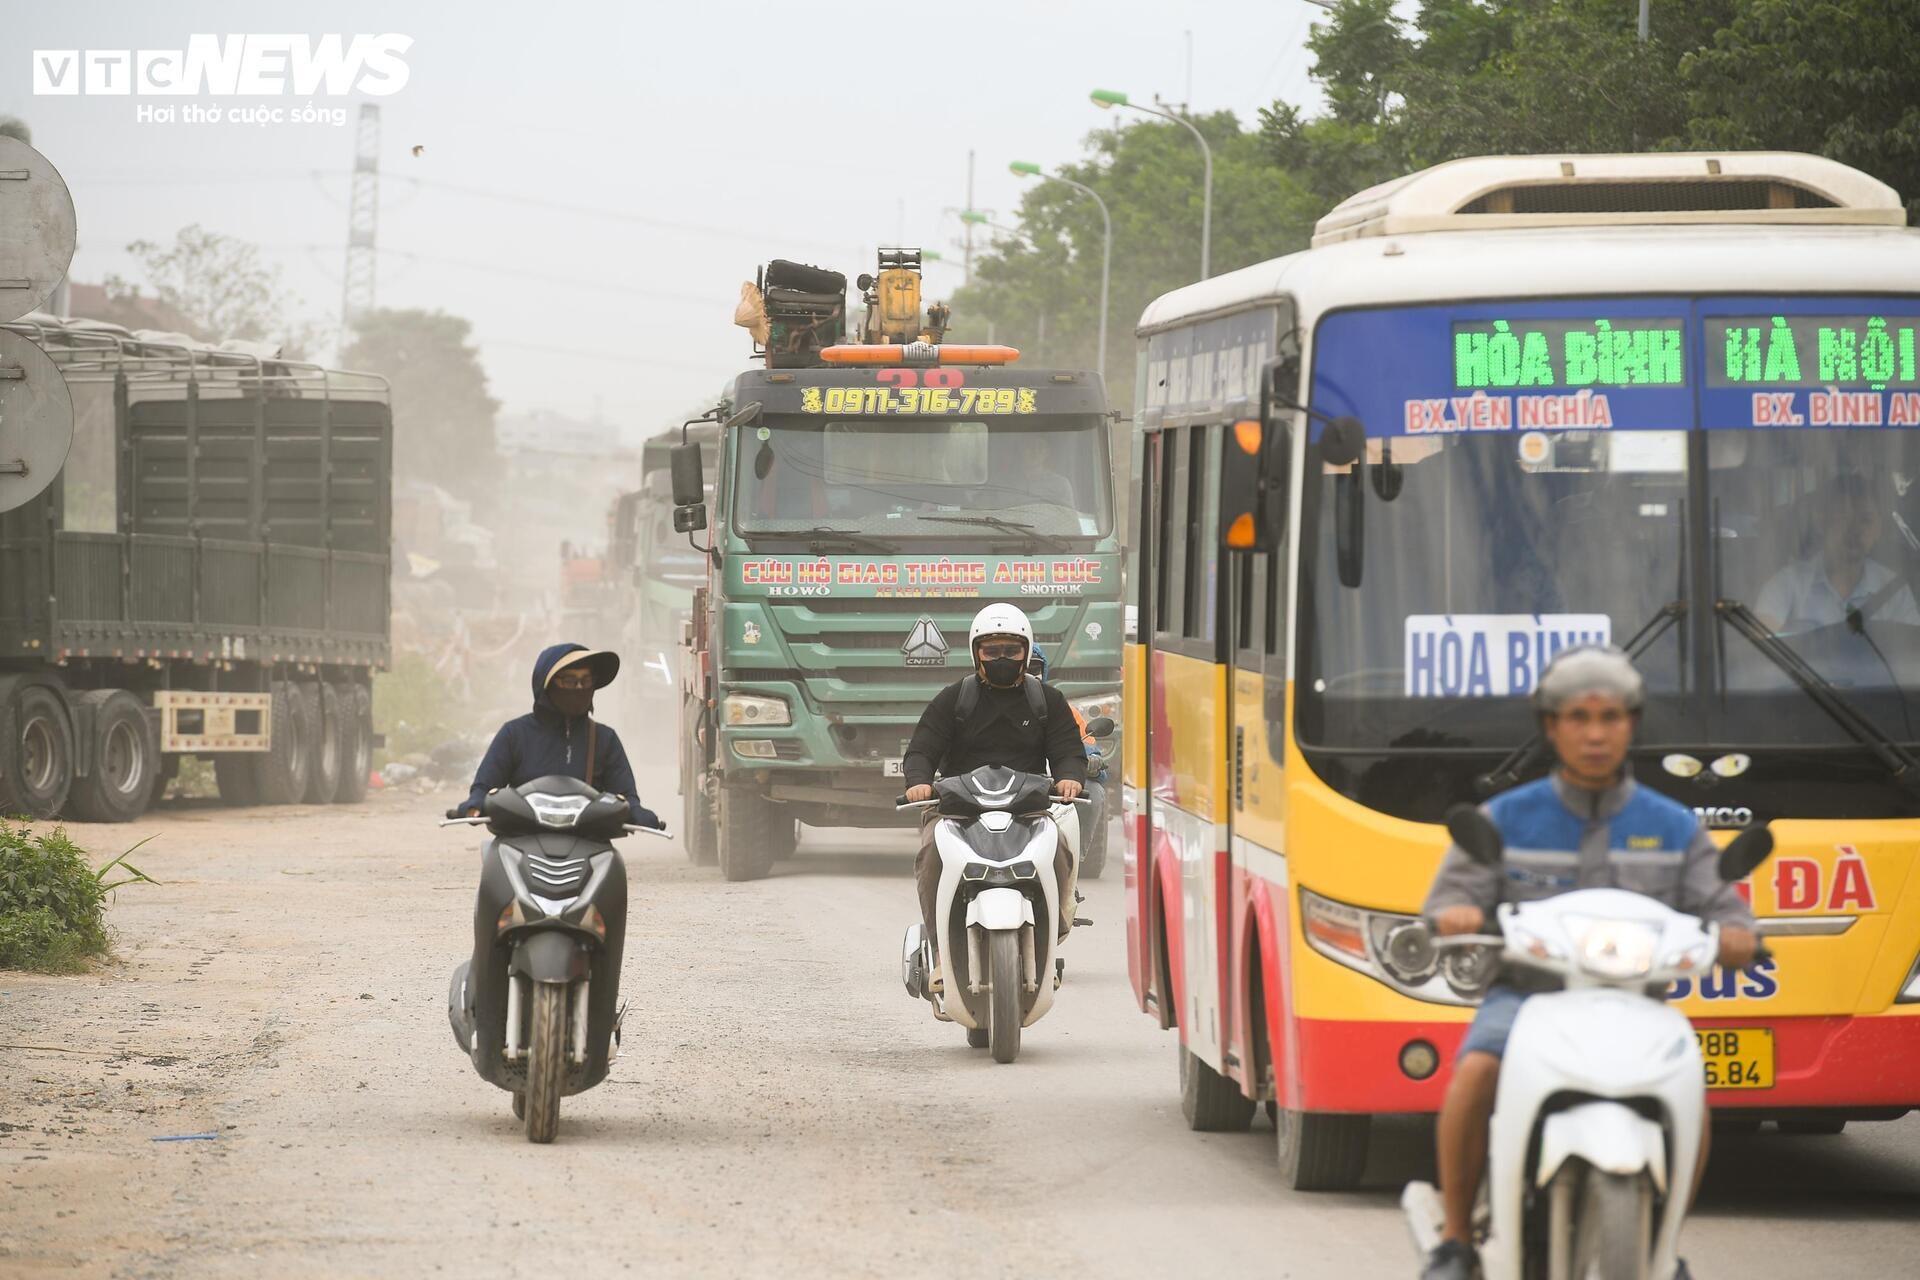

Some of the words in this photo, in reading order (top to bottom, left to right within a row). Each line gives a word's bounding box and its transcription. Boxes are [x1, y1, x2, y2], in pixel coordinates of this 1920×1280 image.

[1455, 320, 1554, 387] HÒA
[1565, 319, 1682, 385] BÌNH
[1818, 316, 1915, 390] NỘI
[824, 387, 1017, 414] 0911-316-789
[1517, 388, 1613, 429] NGHĨA
[1752, 393, 1804, 426] BX.
[1809, 384, 1883, 426] BÌNH
[743, 558, 792, 584] CỨU
[838, 562, 898, 584] GIAO
[904, 557, 986, 584] THÔNG
[993, 562, 1045, 584] ANH
[1020, 584, 1081, 594] SINOTRUK
[768, 587, 831, 596] HOWO
[1411, 615, 1492, 697] HÒA
[1508, 614, 1604, 696] BÌ
[1773, 845, 1877, 911] ĐÀ
